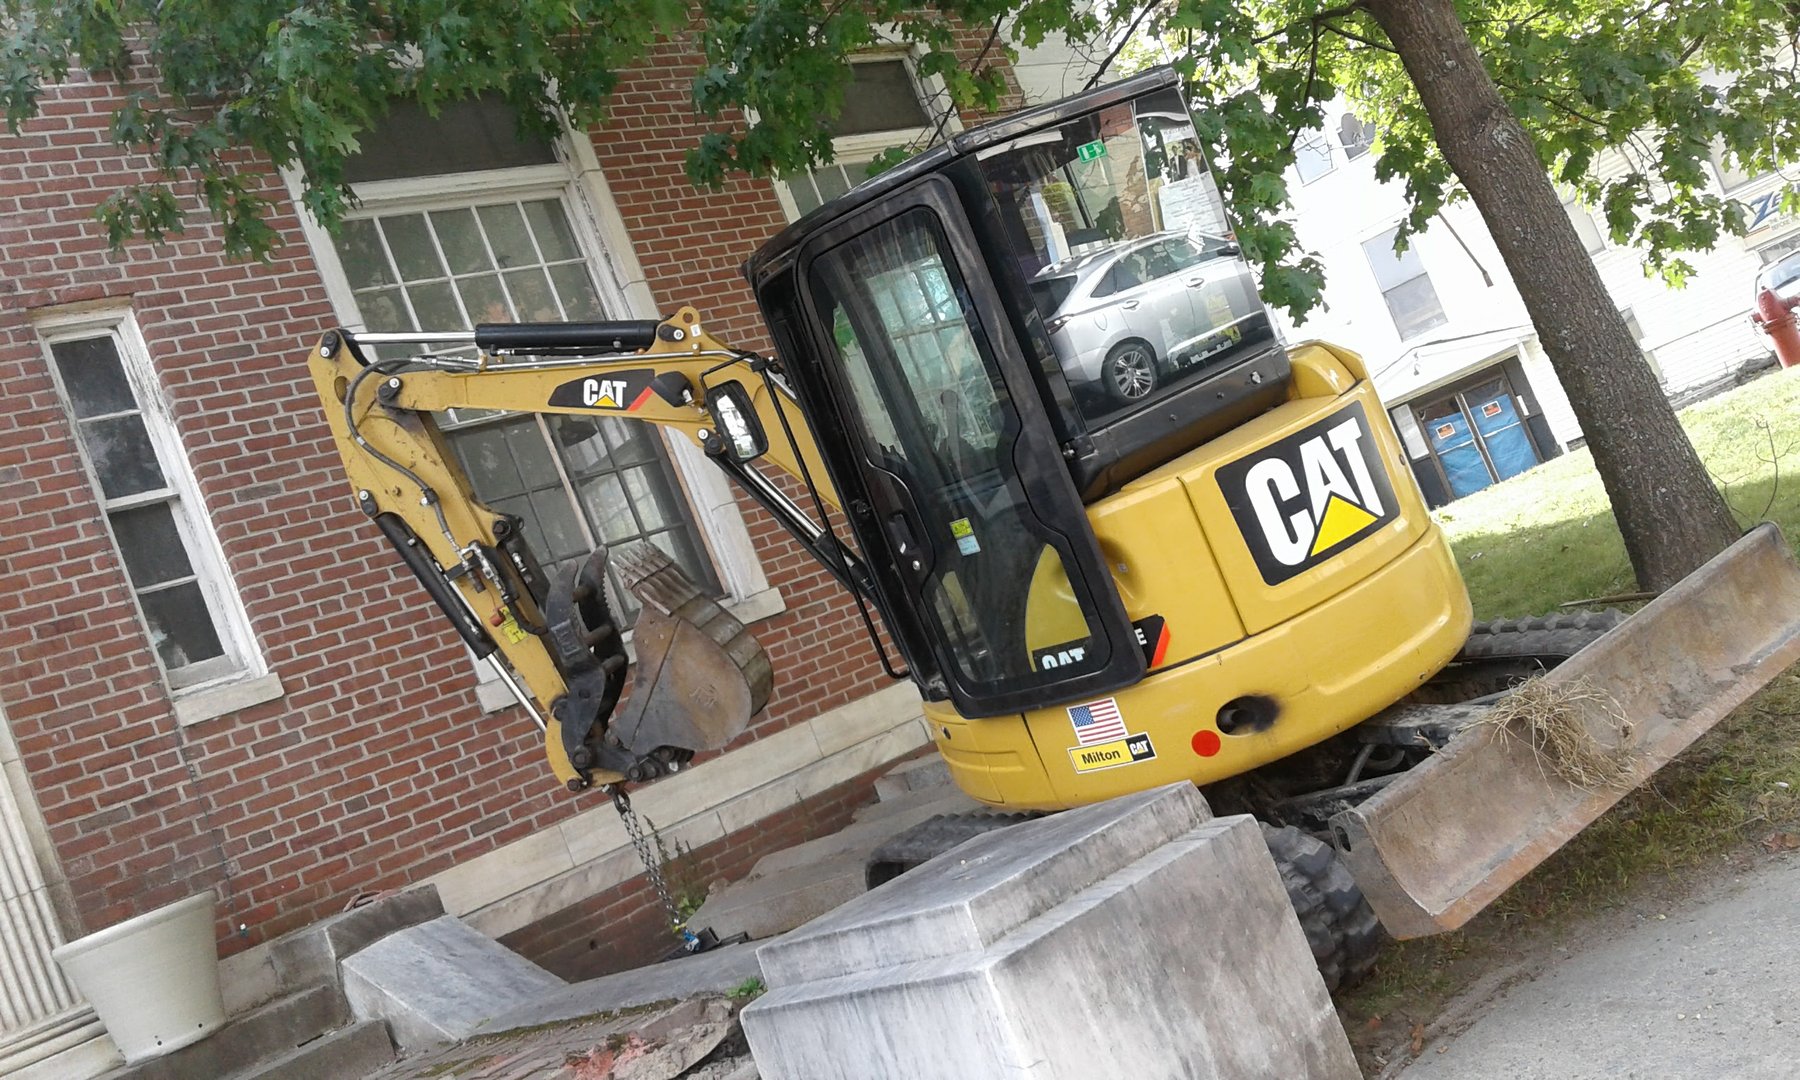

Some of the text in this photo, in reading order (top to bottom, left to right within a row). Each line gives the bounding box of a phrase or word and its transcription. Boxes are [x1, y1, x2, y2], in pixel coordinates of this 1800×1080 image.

[583, 378, 627, 408] CAT
[1245, 416, 1385, 566] CAT
[1081, 740, 1149, 764] Milton CAT
